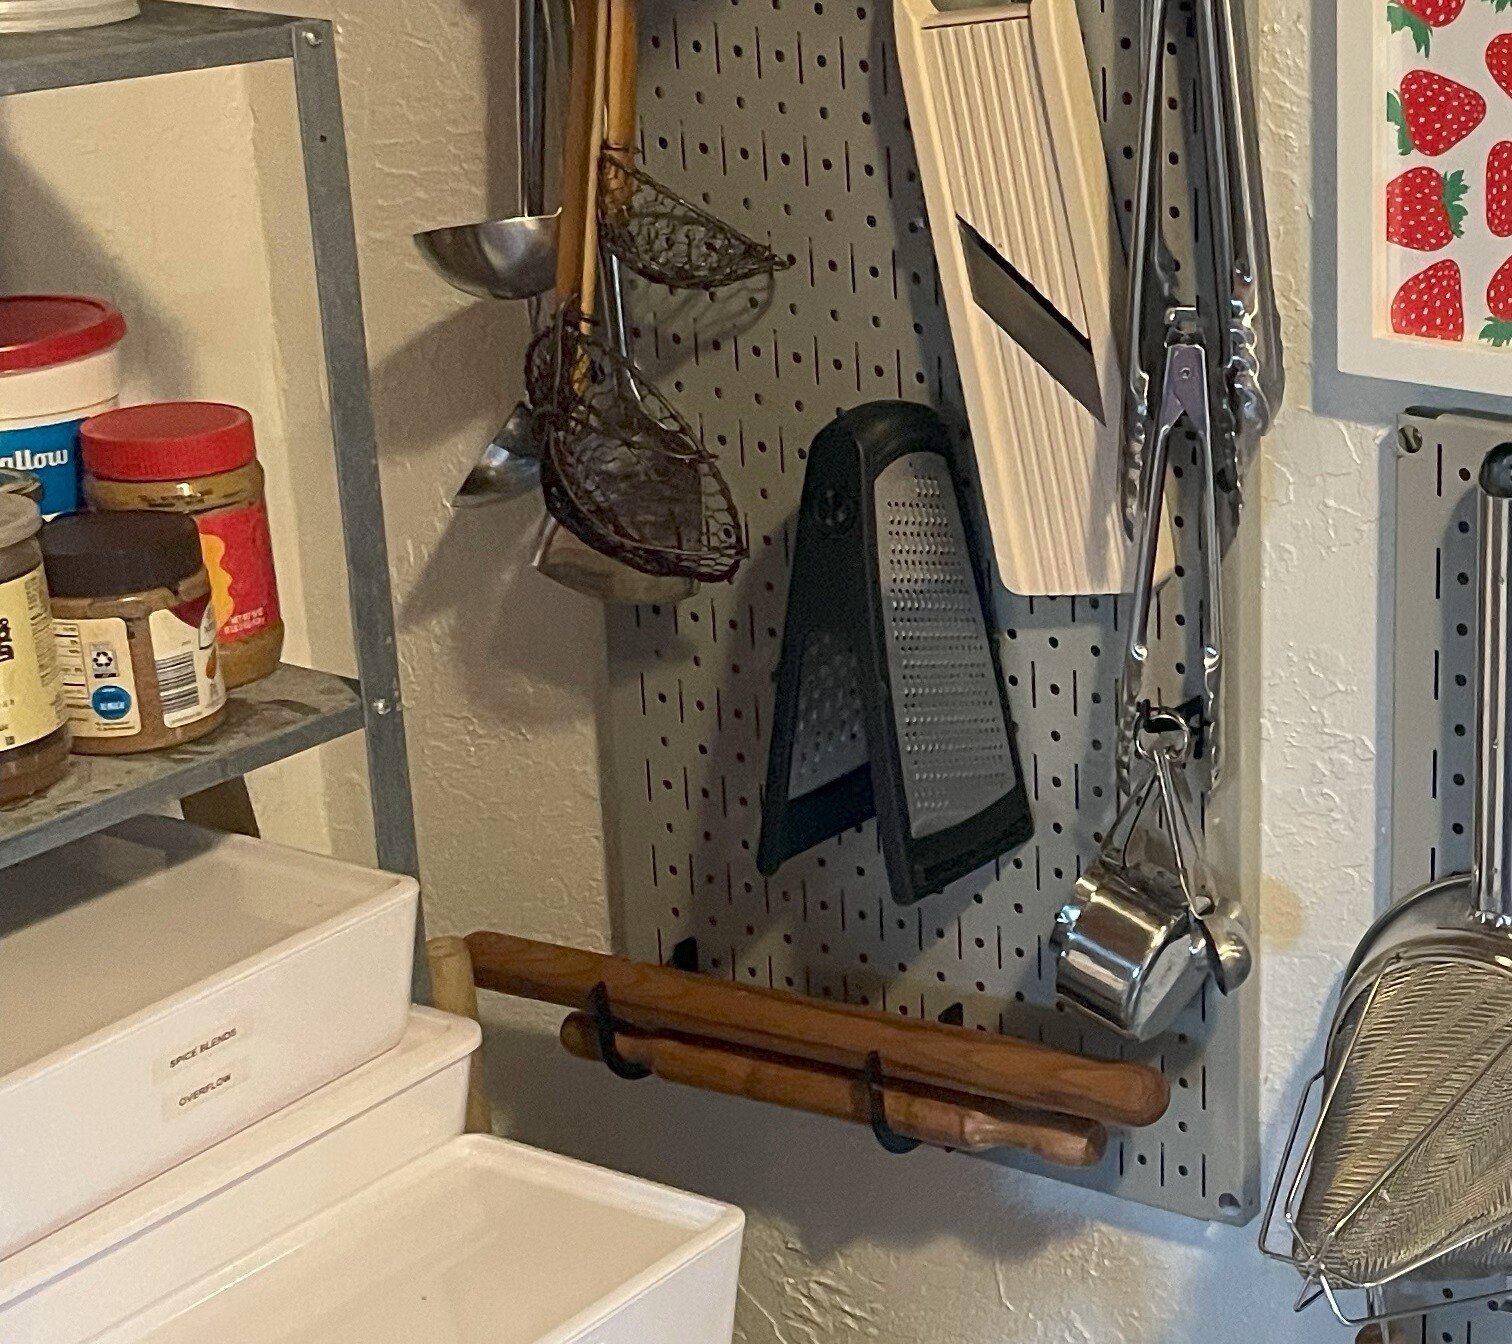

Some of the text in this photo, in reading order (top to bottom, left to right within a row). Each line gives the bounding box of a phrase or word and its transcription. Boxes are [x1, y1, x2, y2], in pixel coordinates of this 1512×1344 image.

[169, 1027, 237, 1068] SPICE BLENDS
[178, 1072, 231, 1106] OVERFLOW
